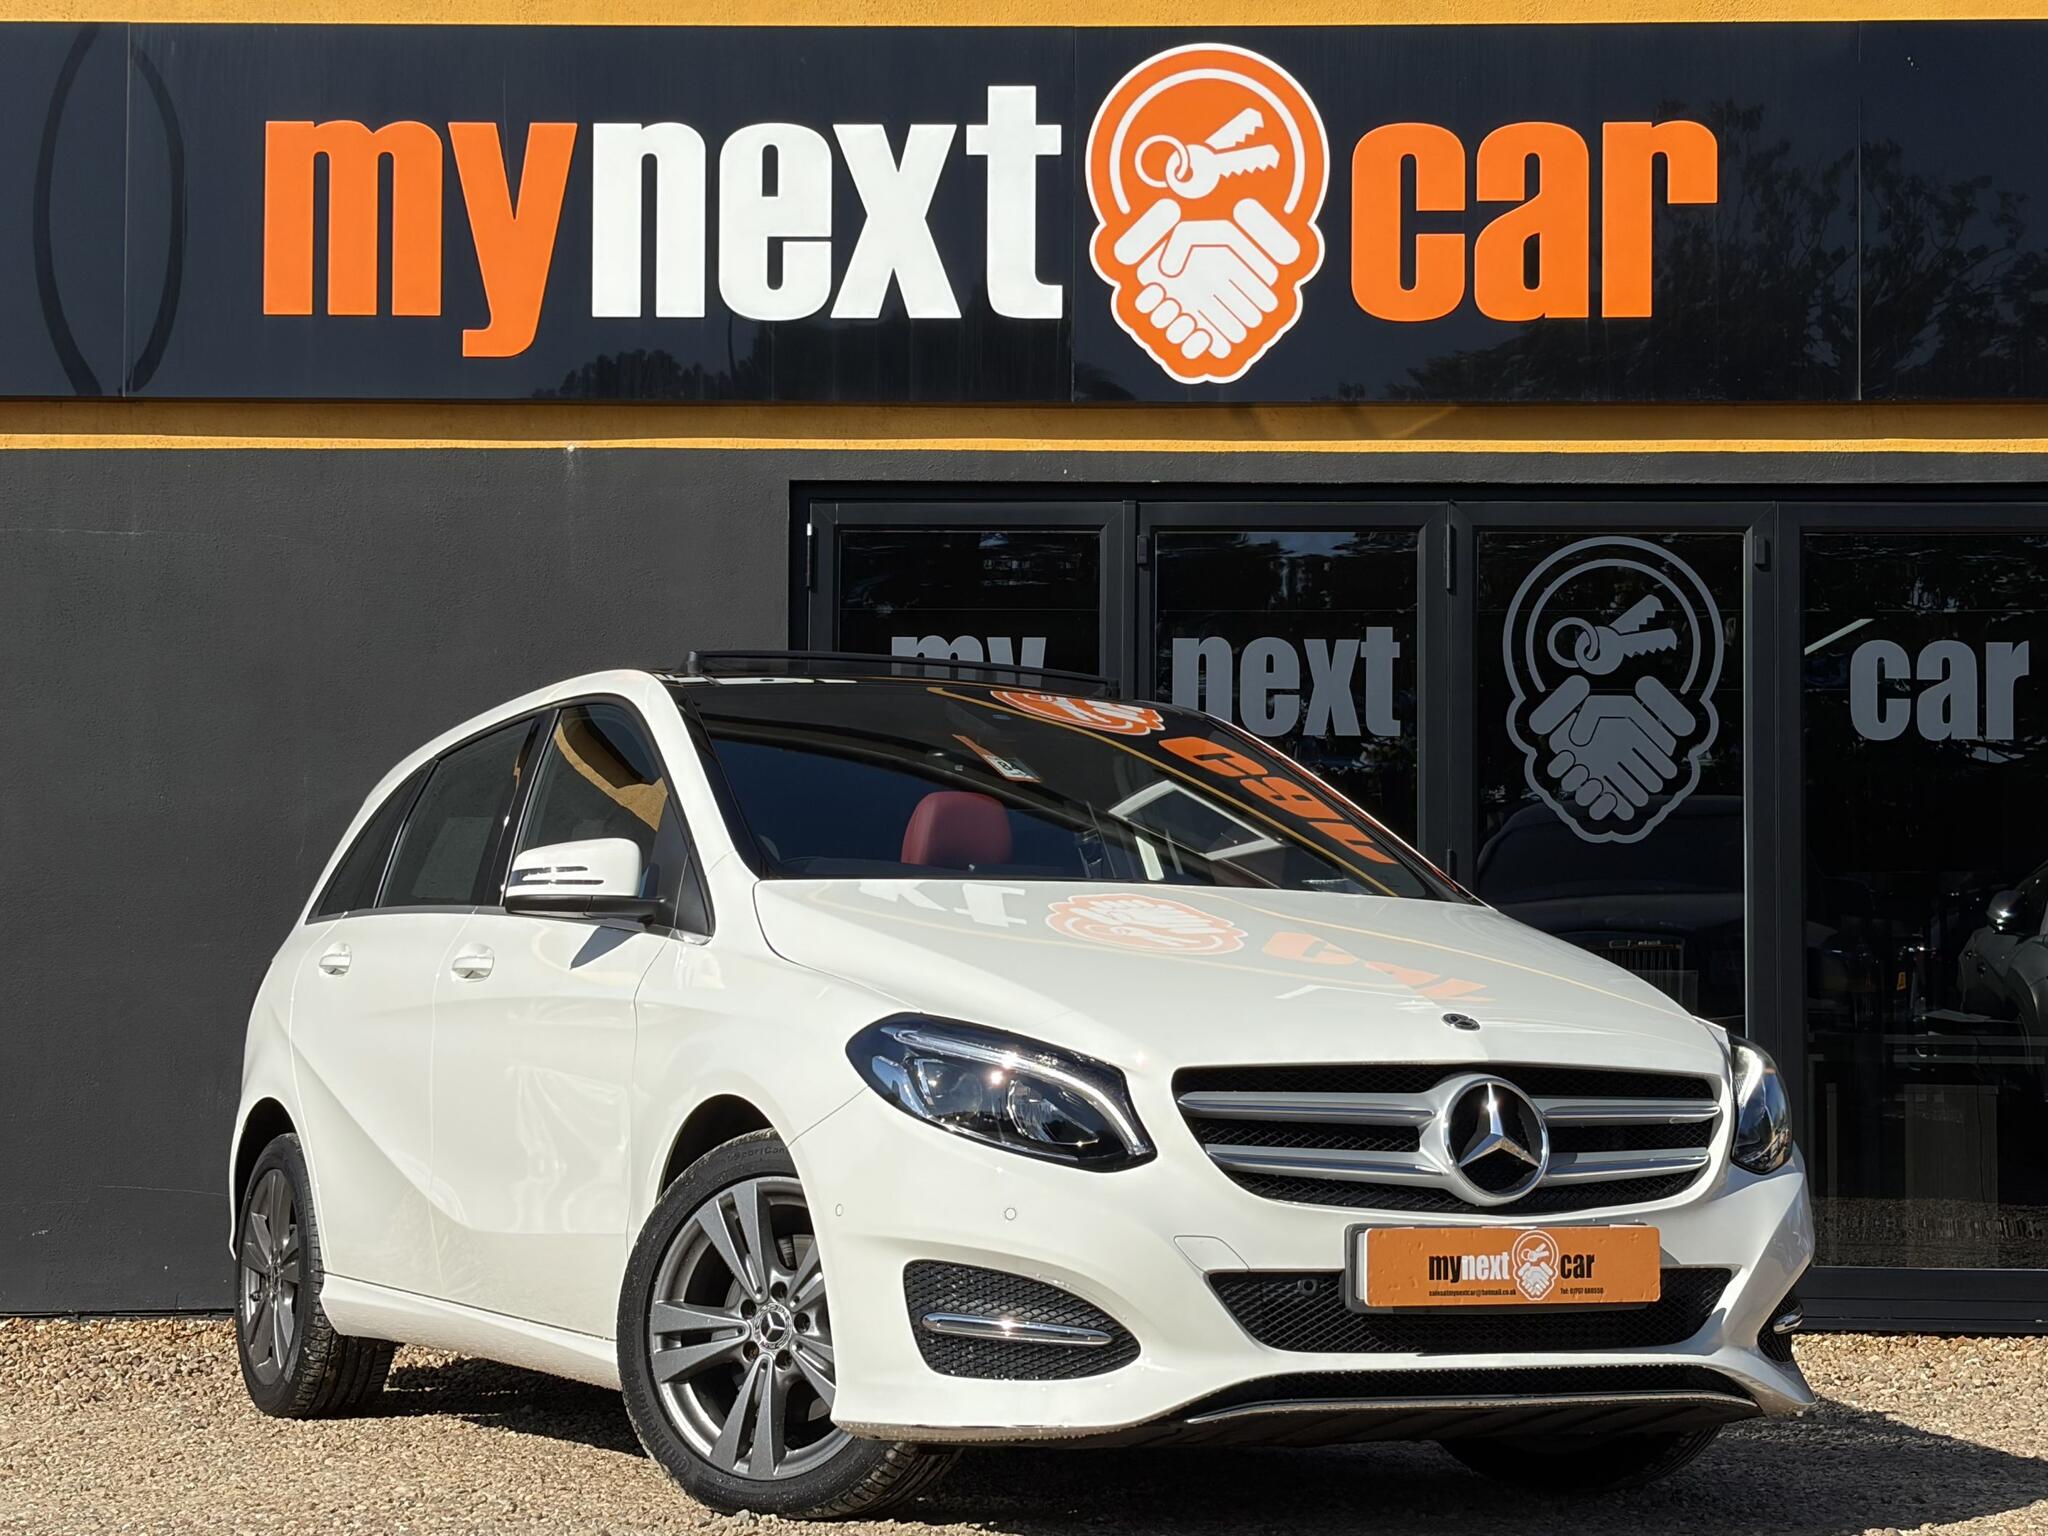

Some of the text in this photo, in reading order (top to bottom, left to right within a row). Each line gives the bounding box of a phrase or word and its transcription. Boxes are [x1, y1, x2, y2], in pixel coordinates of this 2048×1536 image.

[1351, 120, 1718, 322] car
[1172, 626, 1401, 737] next
[1850, 639, 2030, 741] car
[1559, 1253, 1595, 1279] car
